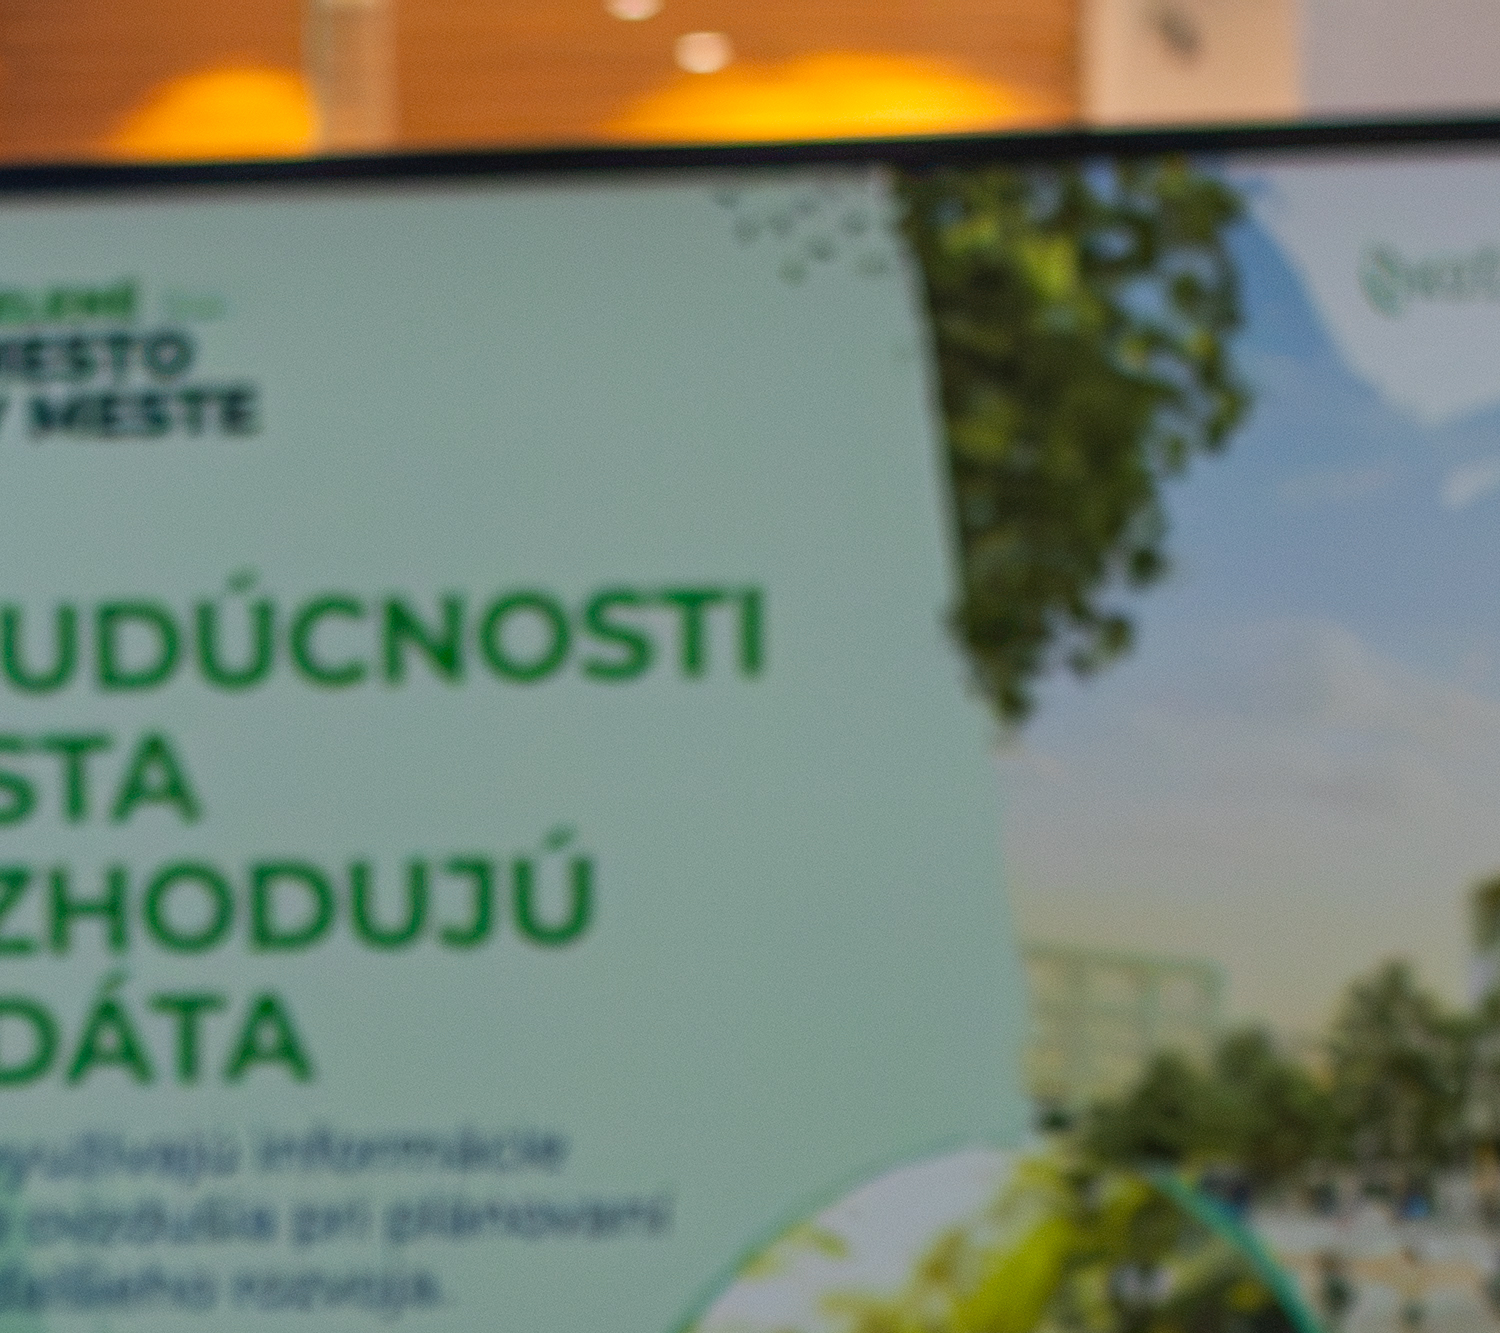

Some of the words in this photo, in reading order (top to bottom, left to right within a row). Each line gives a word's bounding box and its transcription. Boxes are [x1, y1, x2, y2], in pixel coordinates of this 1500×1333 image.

[31, 384, 260, 441] MESTE
[262, 1126, 567, 1174] informácie
[292, 1196, 374, 1254] pri
[389, 1188, 677, 1250] plánovaní
